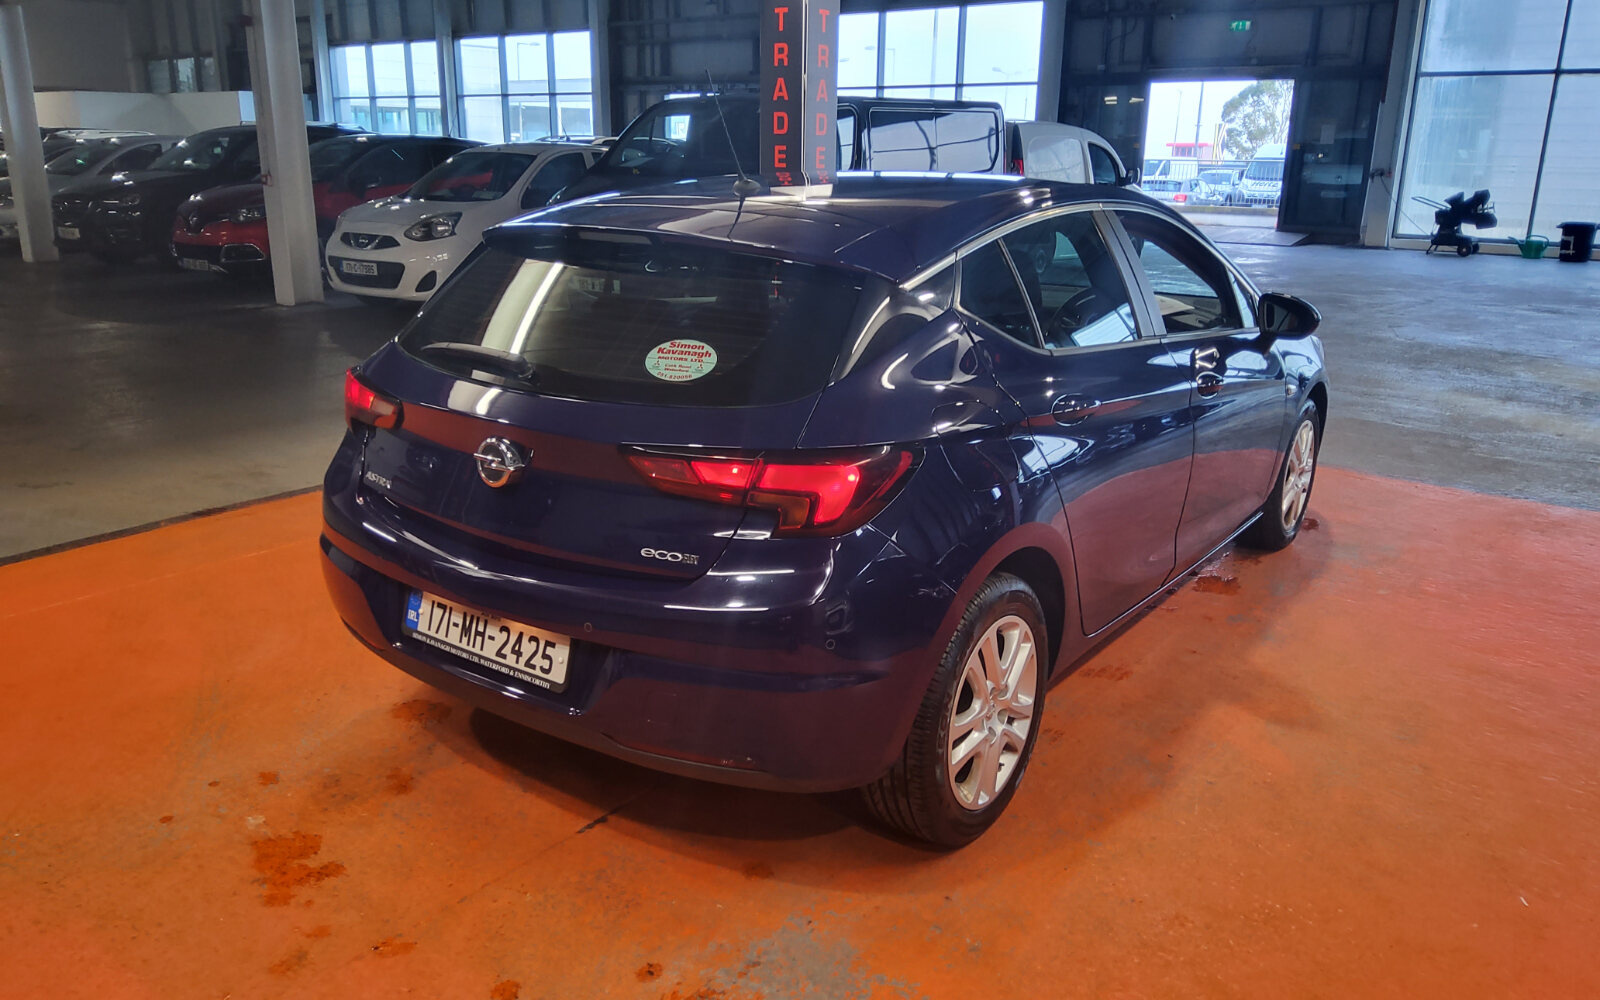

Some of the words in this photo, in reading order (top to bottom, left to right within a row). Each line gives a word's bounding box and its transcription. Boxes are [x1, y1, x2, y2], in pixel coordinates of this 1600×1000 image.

[773, 7, 789, 168] TRADE
[815, 9, 830, 169] TRADE
[657, 347, 712, 359] Kavanagh
[669, 341, 705, 350] Simon
[408, 609, 419, 622] IRL
[427, 600, 557, 676] 171-MH-2425
[480, 658, 510, 675] WATERFORD
